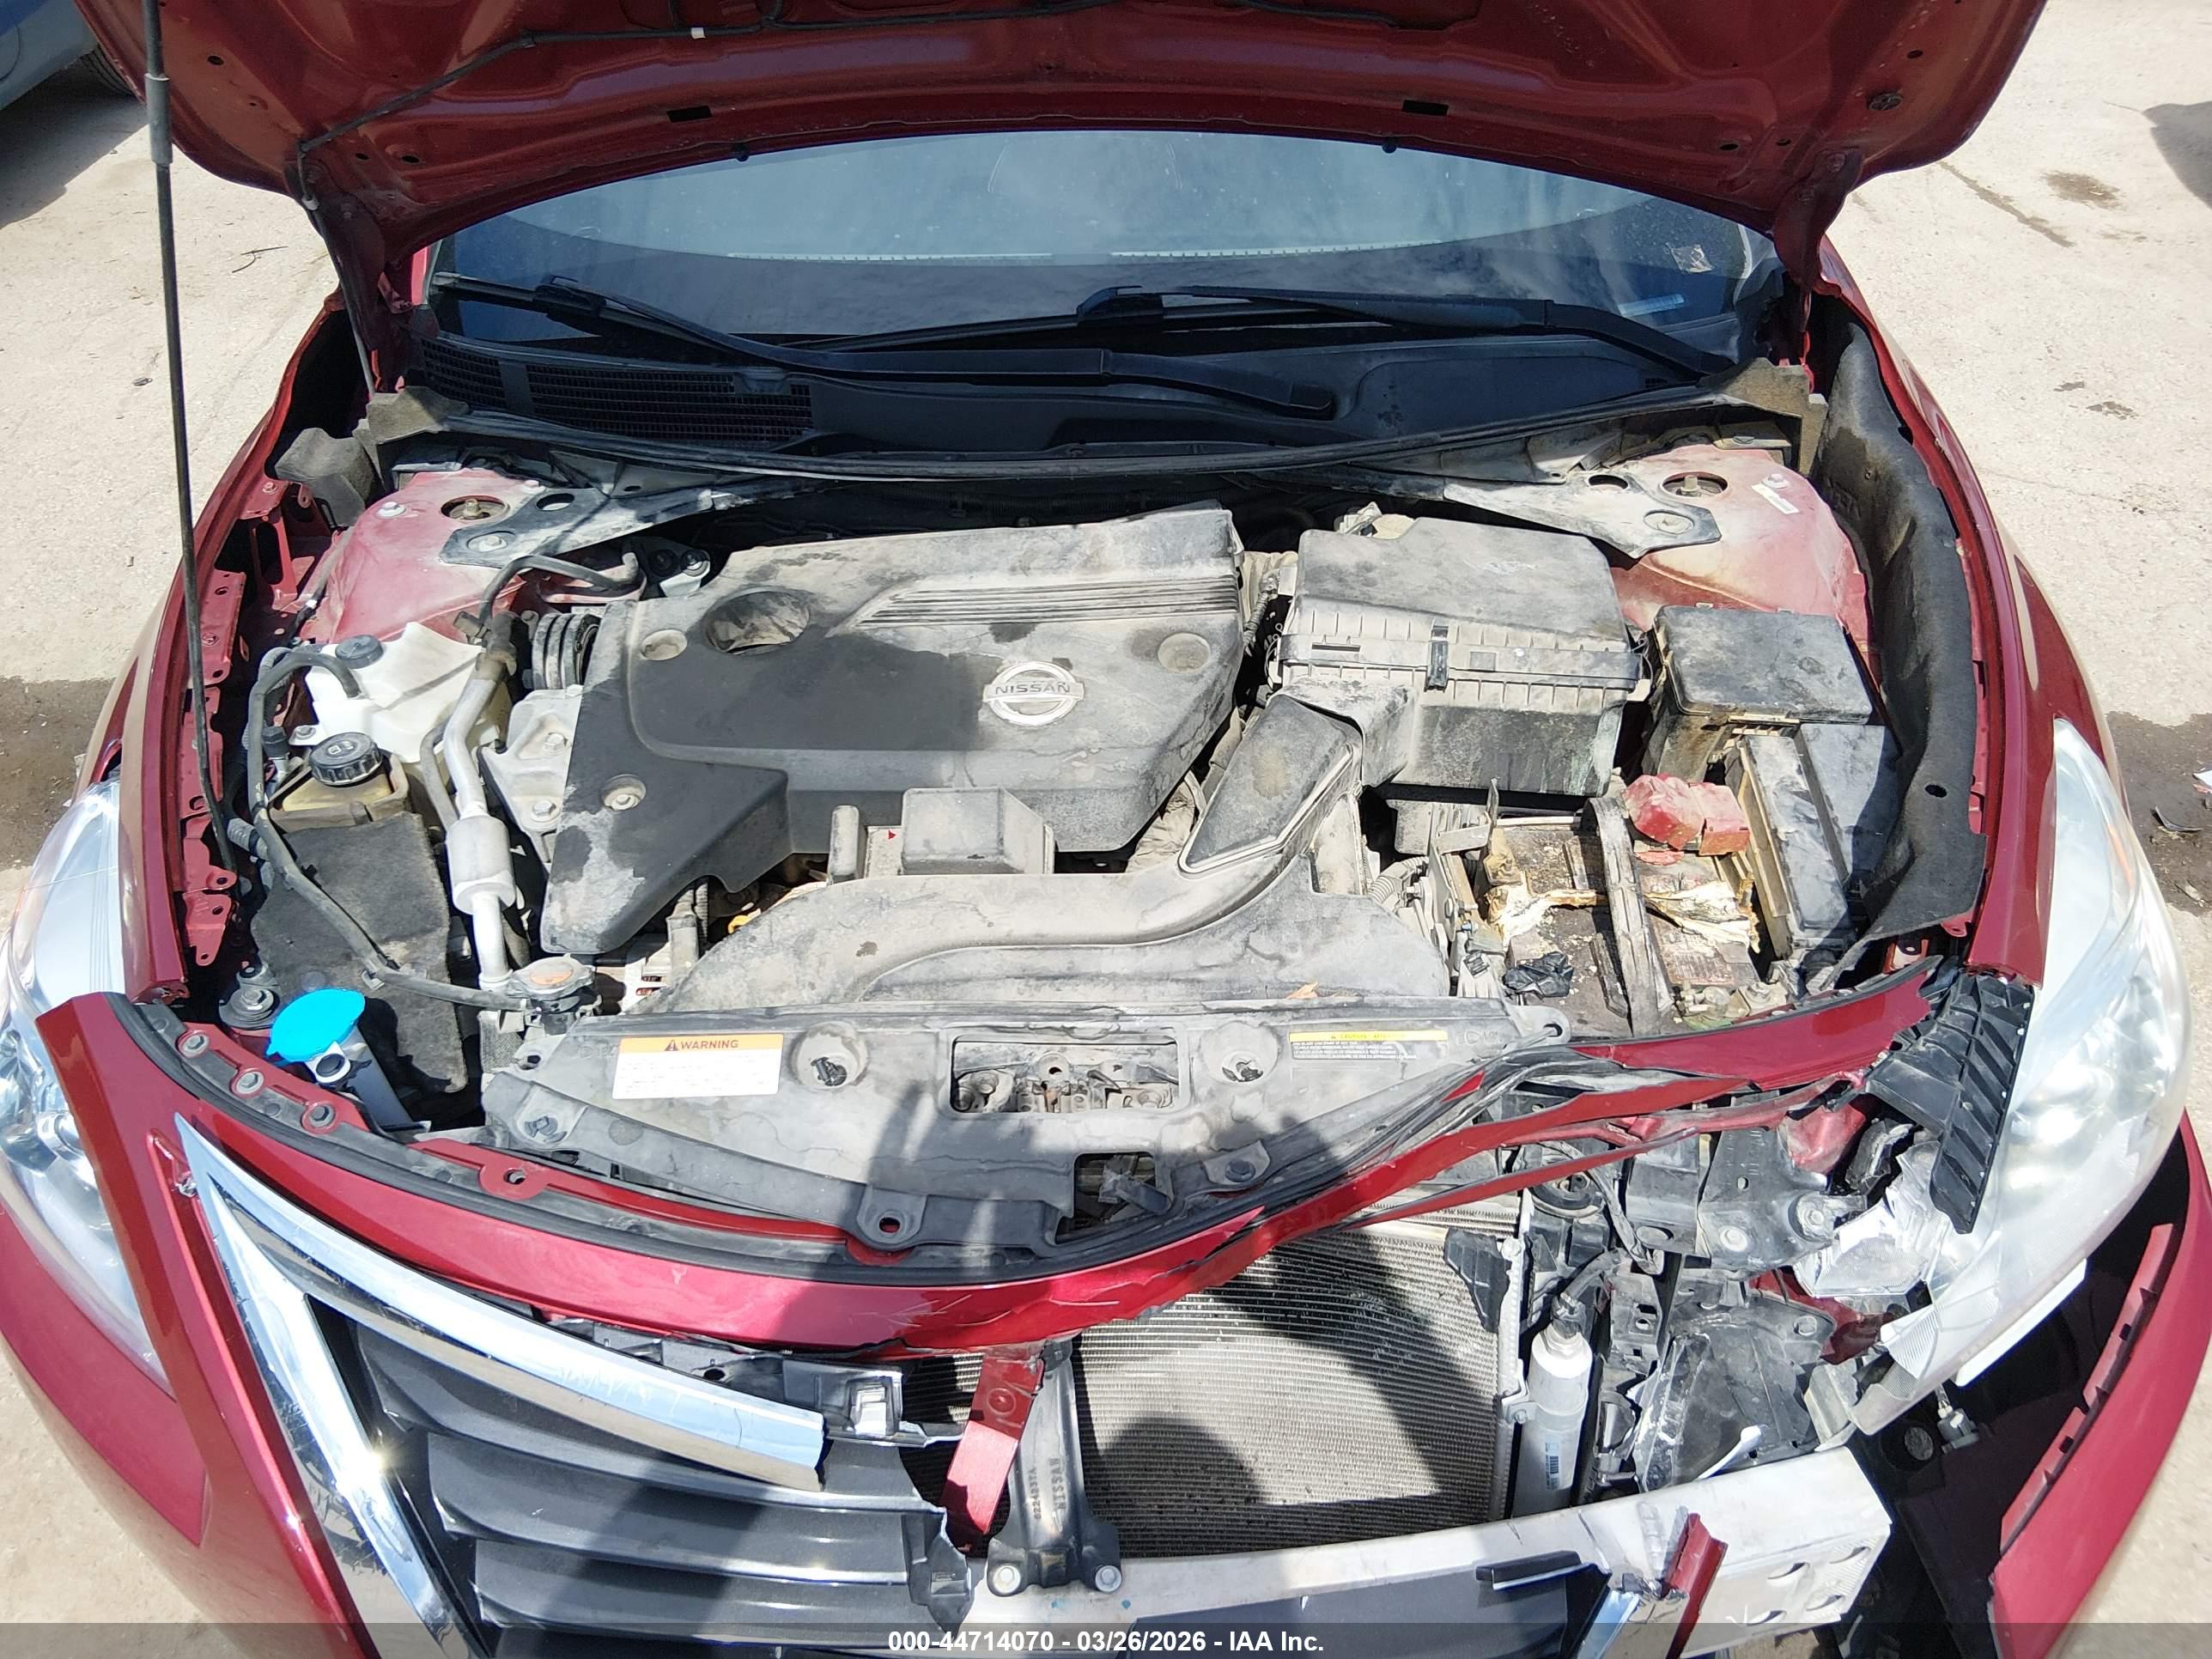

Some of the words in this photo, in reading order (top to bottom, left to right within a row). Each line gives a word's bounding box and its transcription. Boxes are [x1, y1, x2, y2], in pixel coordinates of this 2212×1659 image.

[994, 684, 1071, 695] NISSAN
[681, 1039, 739, 1049] WARNING
[1048, 1457, 1067, 1511] NISSAN
